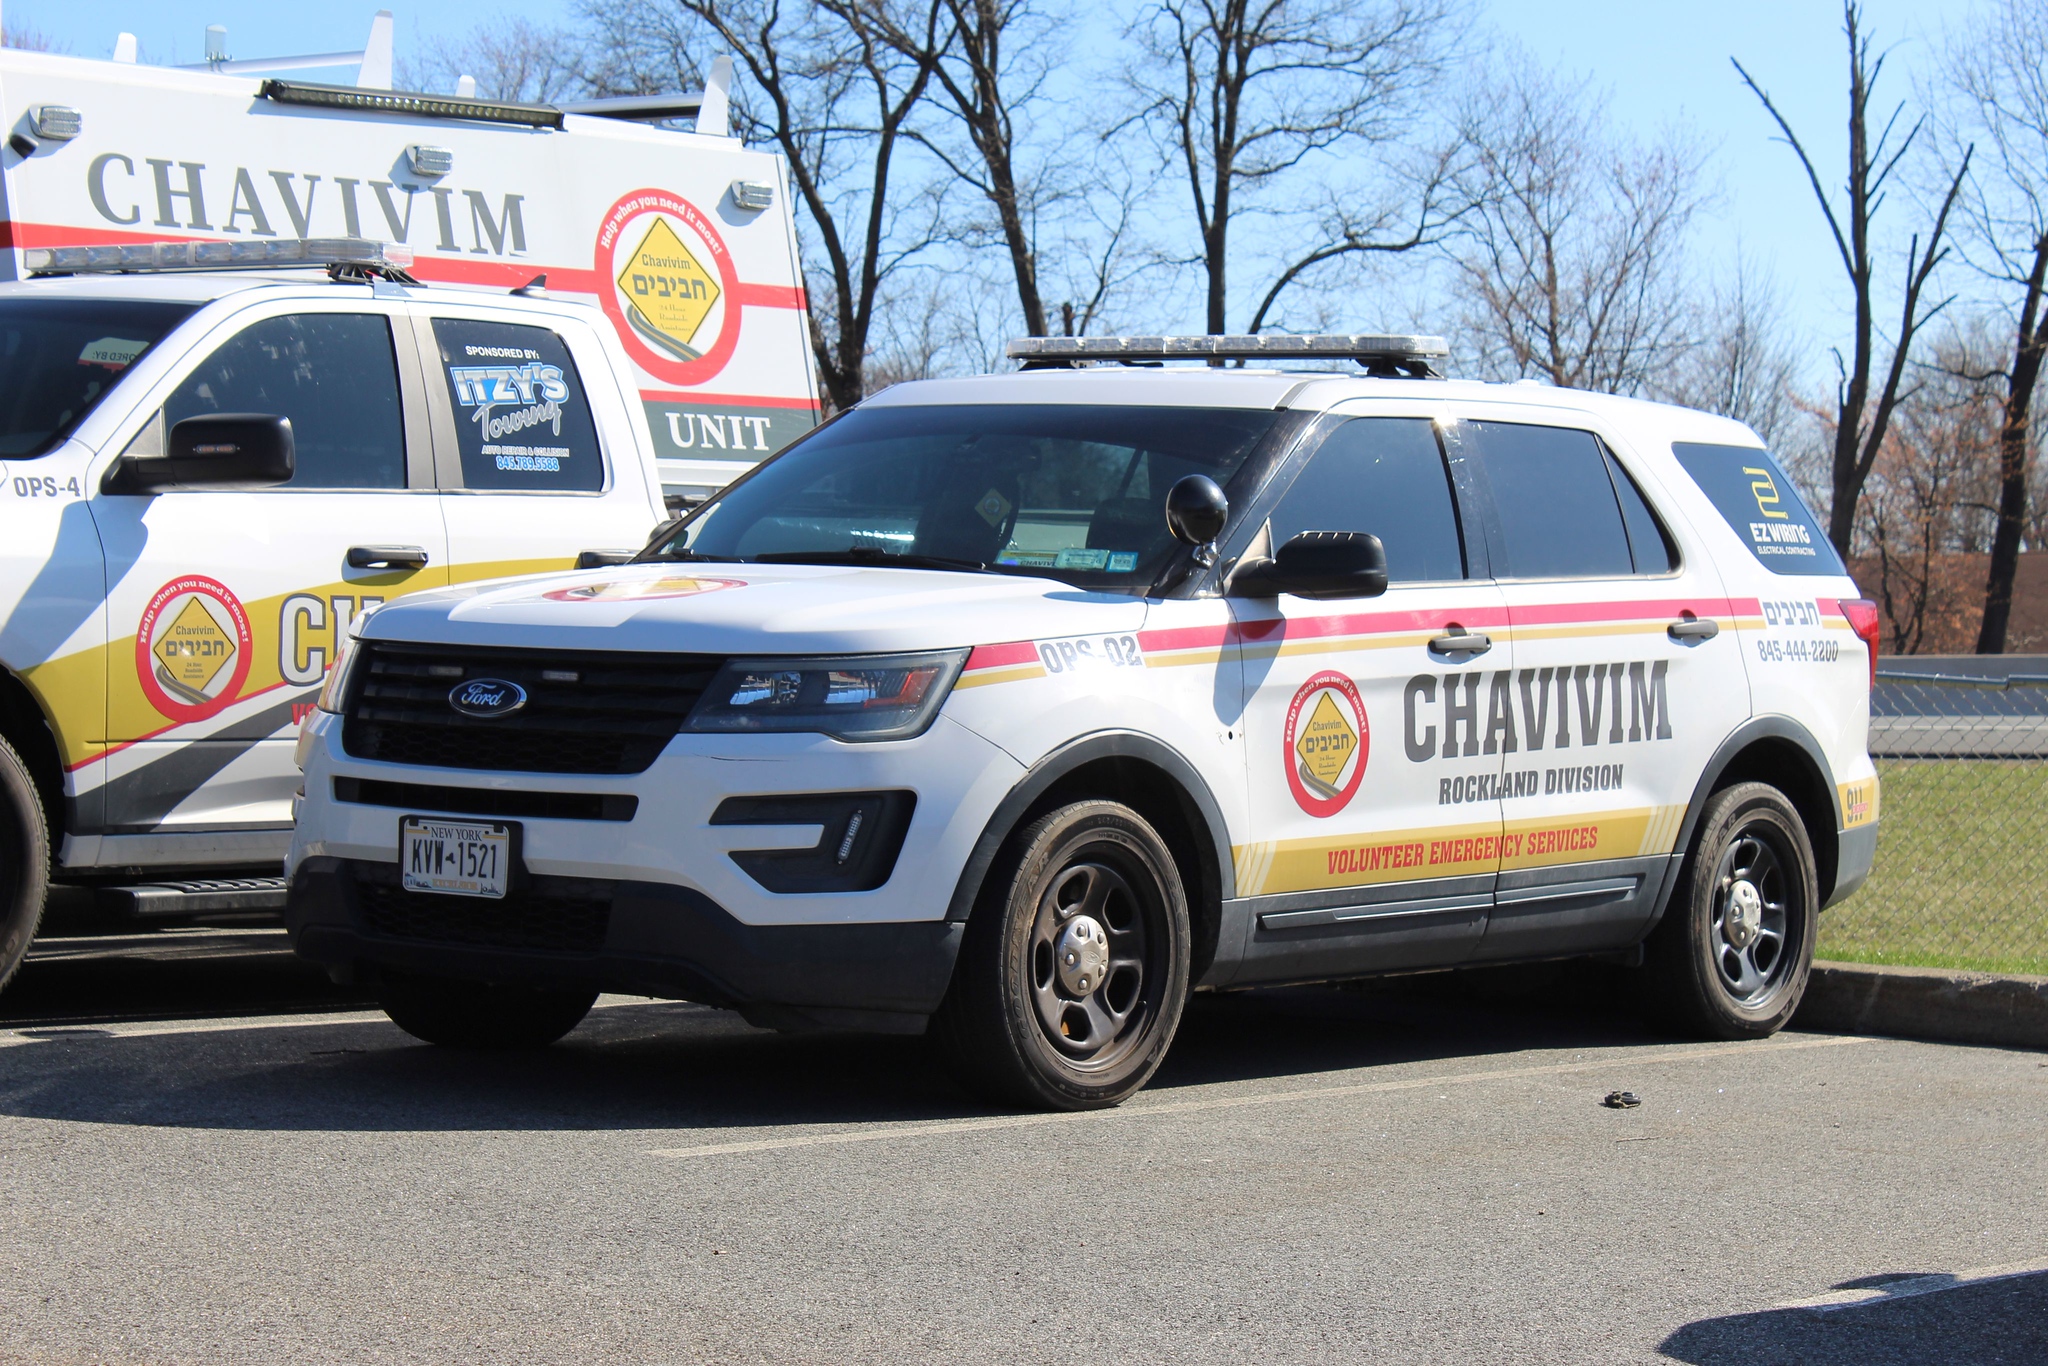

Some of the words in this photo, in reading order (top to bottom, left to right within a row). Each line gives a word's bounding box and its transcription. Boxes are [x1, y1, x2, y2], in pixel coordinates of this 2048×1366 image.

[87, 152, 528, 256] CHAVIVIM
[600, 220, 618, 249] Help
[614, 200, 639, 222] when
[638, 196, 658, 210] you
[659, 197, 686, 216] need
[686, 208, 696, 223] it
[695, 219, 723, 255] most!
[641, 253, 691, 270] Chavivim
[632, 273, 707, 300] חביבים
[465, 345, 523, 359] SPONSORED
[523, 349, 540, 359] BY:
[450, 362, 570, 406] ITZY'S
[471, 400, 562, 442] Towing
[665, 412, 771, 451] UNIT
[481, 445, 501, 455] AUTO
[502, 446, 528, 456] REPAIR
[533, 447, 570, 457] COLLISION
[496, 456, 560, 471] 845.789.5588
[13, 476, 81, 497] OPS-4
[1749, 522, 1771, 542] EZ
[1767, 523, 1811, 544] WIRING
[140, 610, 155, 643] Help
[152, 586, 178, 610] when
[177, 580, 198, 591] you
[198, 580, 224, 597] need
[223, 593, 233, 605] it
[231, 602, 250, 643] most!
[1762, 600, 1820, 626] חביבים
[175, 625, 215, 635] Chavivim
[165, 640, 225, 657] חביבים
[1040, 635, 1143, 673] OPS-02
[1757, 640, 1839, 663] 845-444-2200
[461, 683, 506, 707] Ford
[1286, 708, 1296, 743] Help
[1294, 683, 1314, 706] when
[1314, 676, 1330, 688] you
[1330, 676, 1350, 690] need
[1349, 685, 1355, 697] it
[1353, 695, 1367, 734] most!
[1403, 659, 1673, 763] CHAVIVIM
[1312, 720, 1342, 732] Chavivim
[1305, 733, 1350, 754] חביבים
[1438, 770, 1538, 805] ROCKLAND
[1544, 764, 1624, 795] DIVISION
[431, 826, 454, 840] NEW
[455, 829, 483, 843] YORK
[412, 839, 445, 875] KVW
[457, 842, 497, 879] 1521
[1328, 843, 1425, 875] VOLUNTEER
[1428, 833, 1524, 865] EMERGENCY
[1527, 826, 1598, 856] SERVICES
